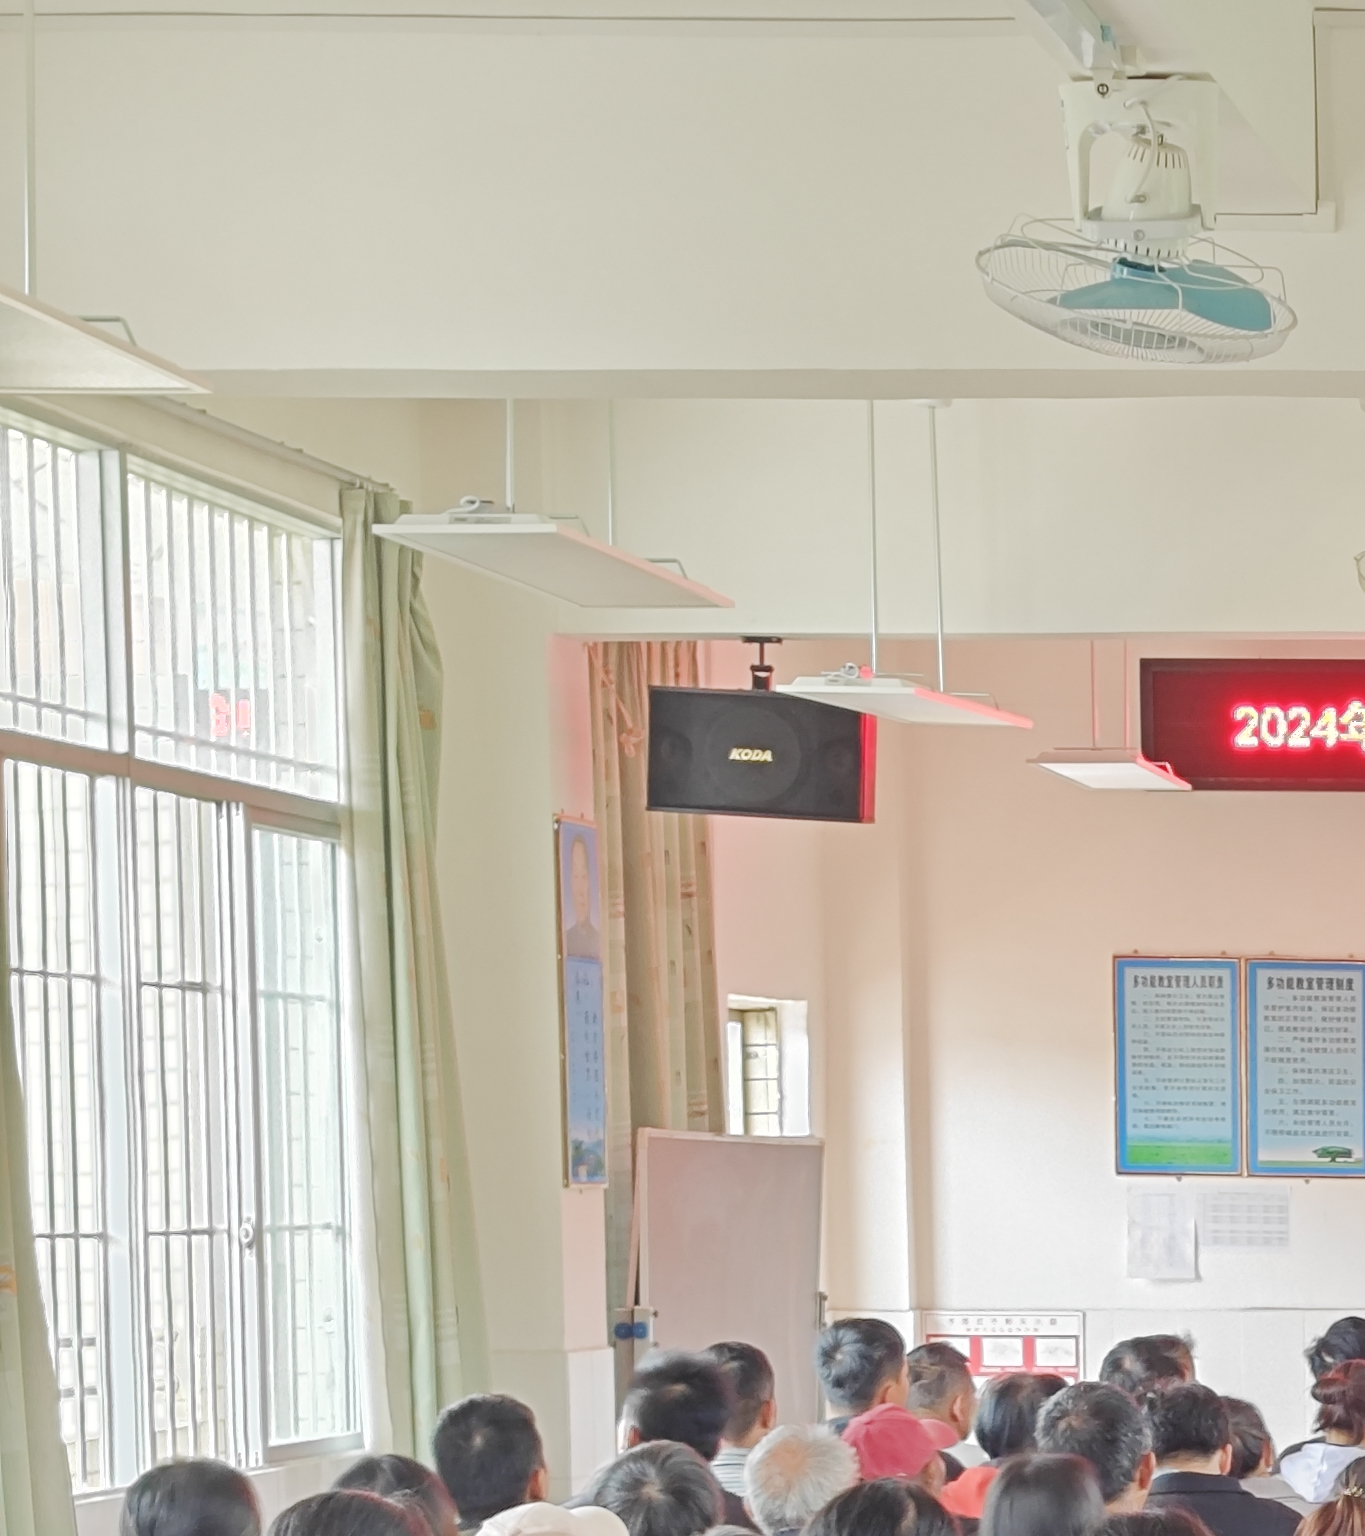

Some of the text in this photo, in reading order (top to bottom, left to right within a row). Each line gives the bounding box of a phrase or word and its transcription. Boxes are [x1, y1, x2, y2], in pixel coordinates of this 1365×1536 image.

[728, 747, 774, 763] KODA
[1266, 976, 1355, 991] 多功能教室管理制度
